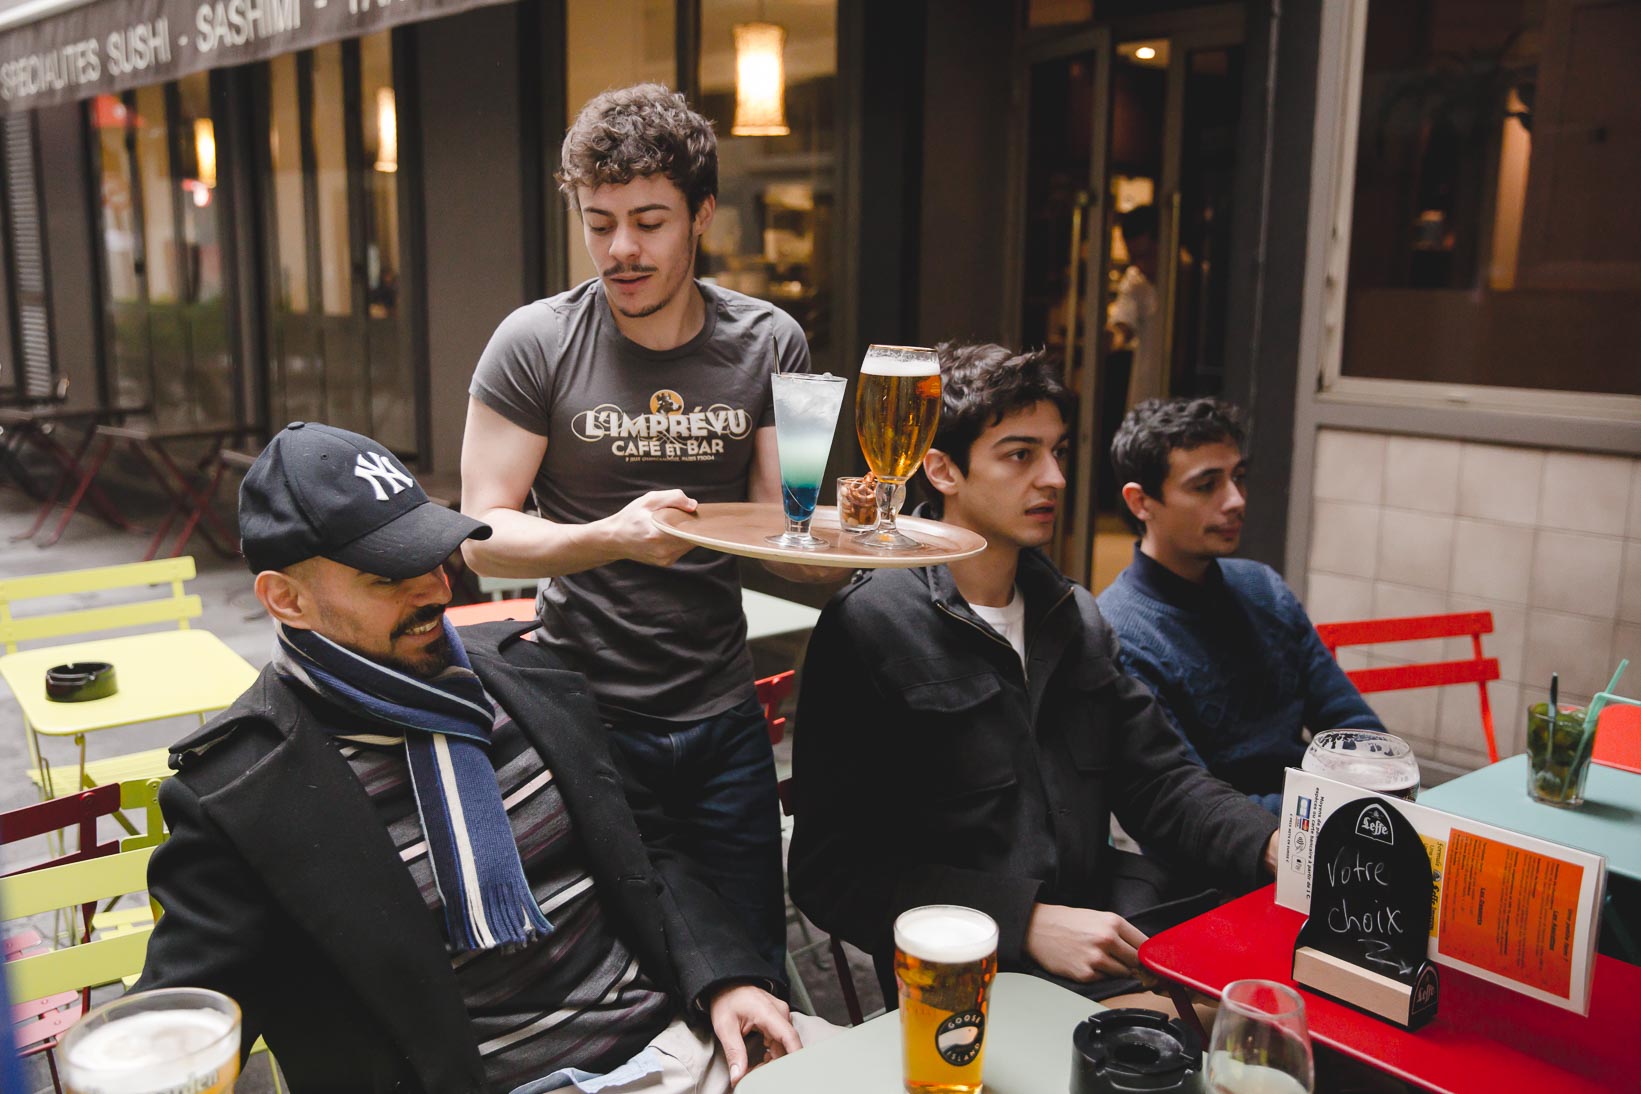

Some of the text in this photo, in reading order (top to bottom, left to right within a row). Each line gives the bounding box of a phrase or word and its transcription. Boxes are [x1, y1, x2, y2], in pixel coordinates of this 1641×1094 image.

[106, 15, 172, 76] SUSHI
[195, 0, 301, 52] SASHIMI
[611, 436, 661, 456] CAFÉ
[687, 439, 724, 454] BAR
[1361, 816, 1389, 836] Leffe
[947, 1014, 981, 1029] GOOSE
[946, 1043, 980, 1062] ISLAND
